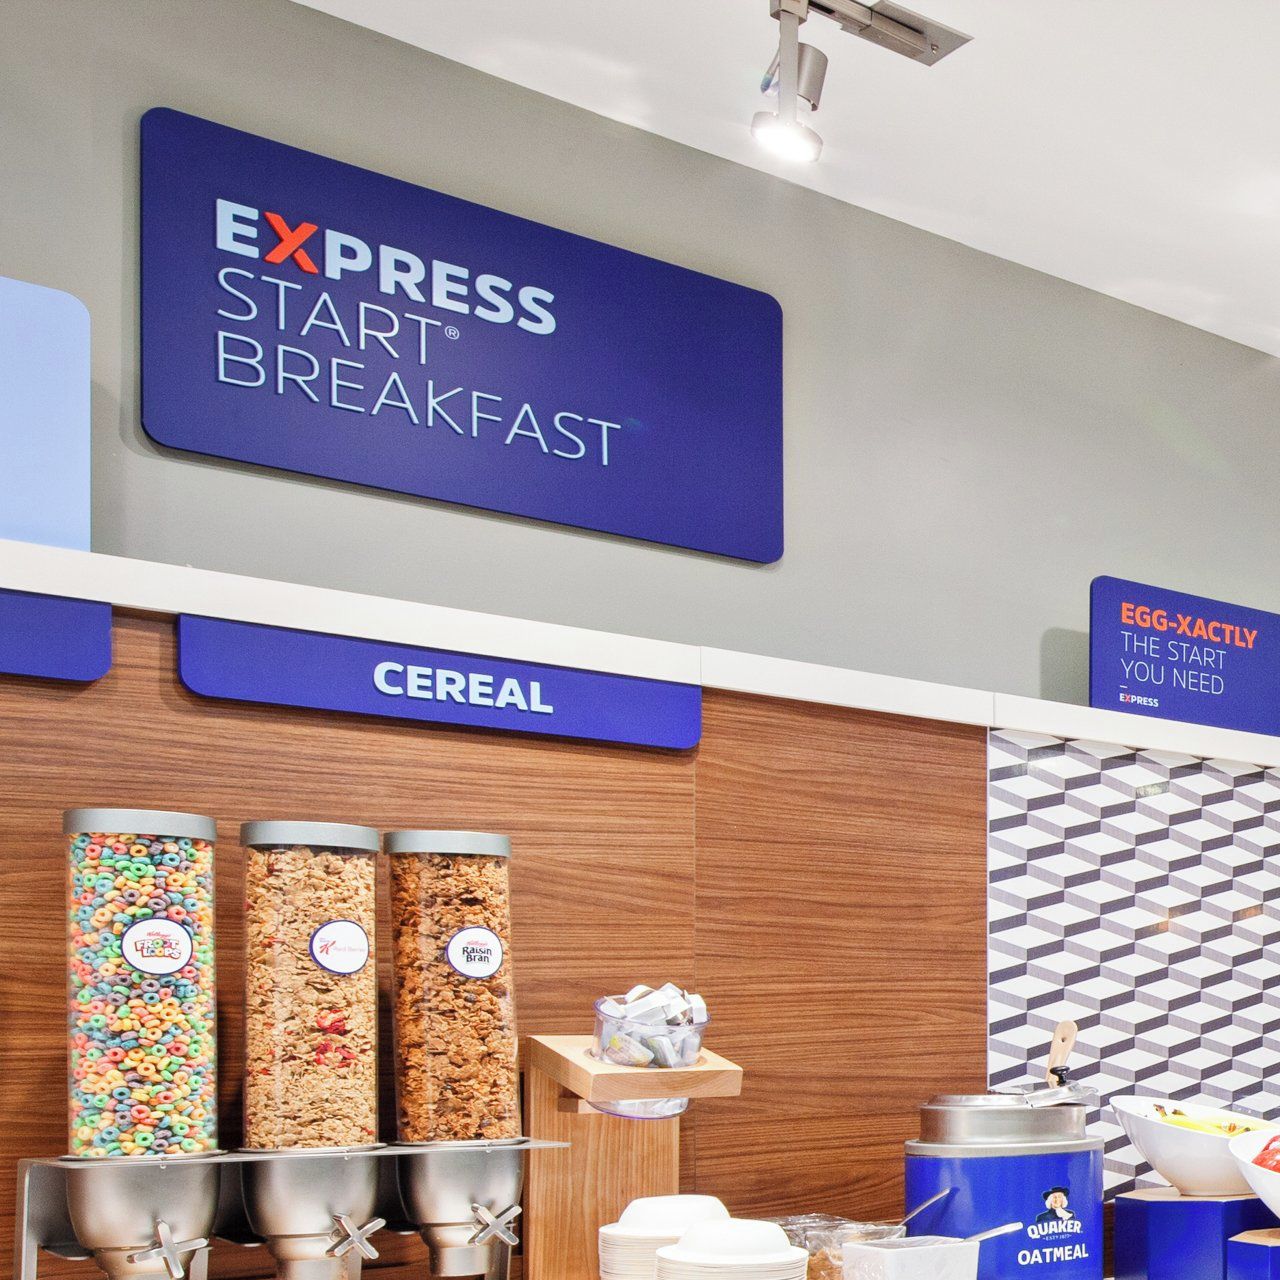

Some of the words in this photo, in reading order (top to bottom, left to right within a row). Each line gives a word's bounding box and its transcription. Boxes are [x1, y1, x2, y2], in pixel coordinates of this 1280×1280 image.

[216, 198, 557, 336] EXPRESS
[217, 330, 622, 467] BREAKFAST
[1121, 602, 1258, 649] EGG-XACTLY
[1120, 631, 1160, 658] THE
[1167, 640, 1227, 670] START
[373, 661, 554, 714] CEREAL
[1120, 658, 1165, 685] YOU
[1173, 667, 1225, 695] NEED
[1119, 692, 1159, 707] EXPRESS
[141, 948, 181, 960] LOOPS
[462, 946, 492, 956] Raisin
[466, 954, 490, 963] Bran
[1026, 1219, 1082, 1239] QUAKER
[1017, 1243, 1089, 1266] OATMEAL
